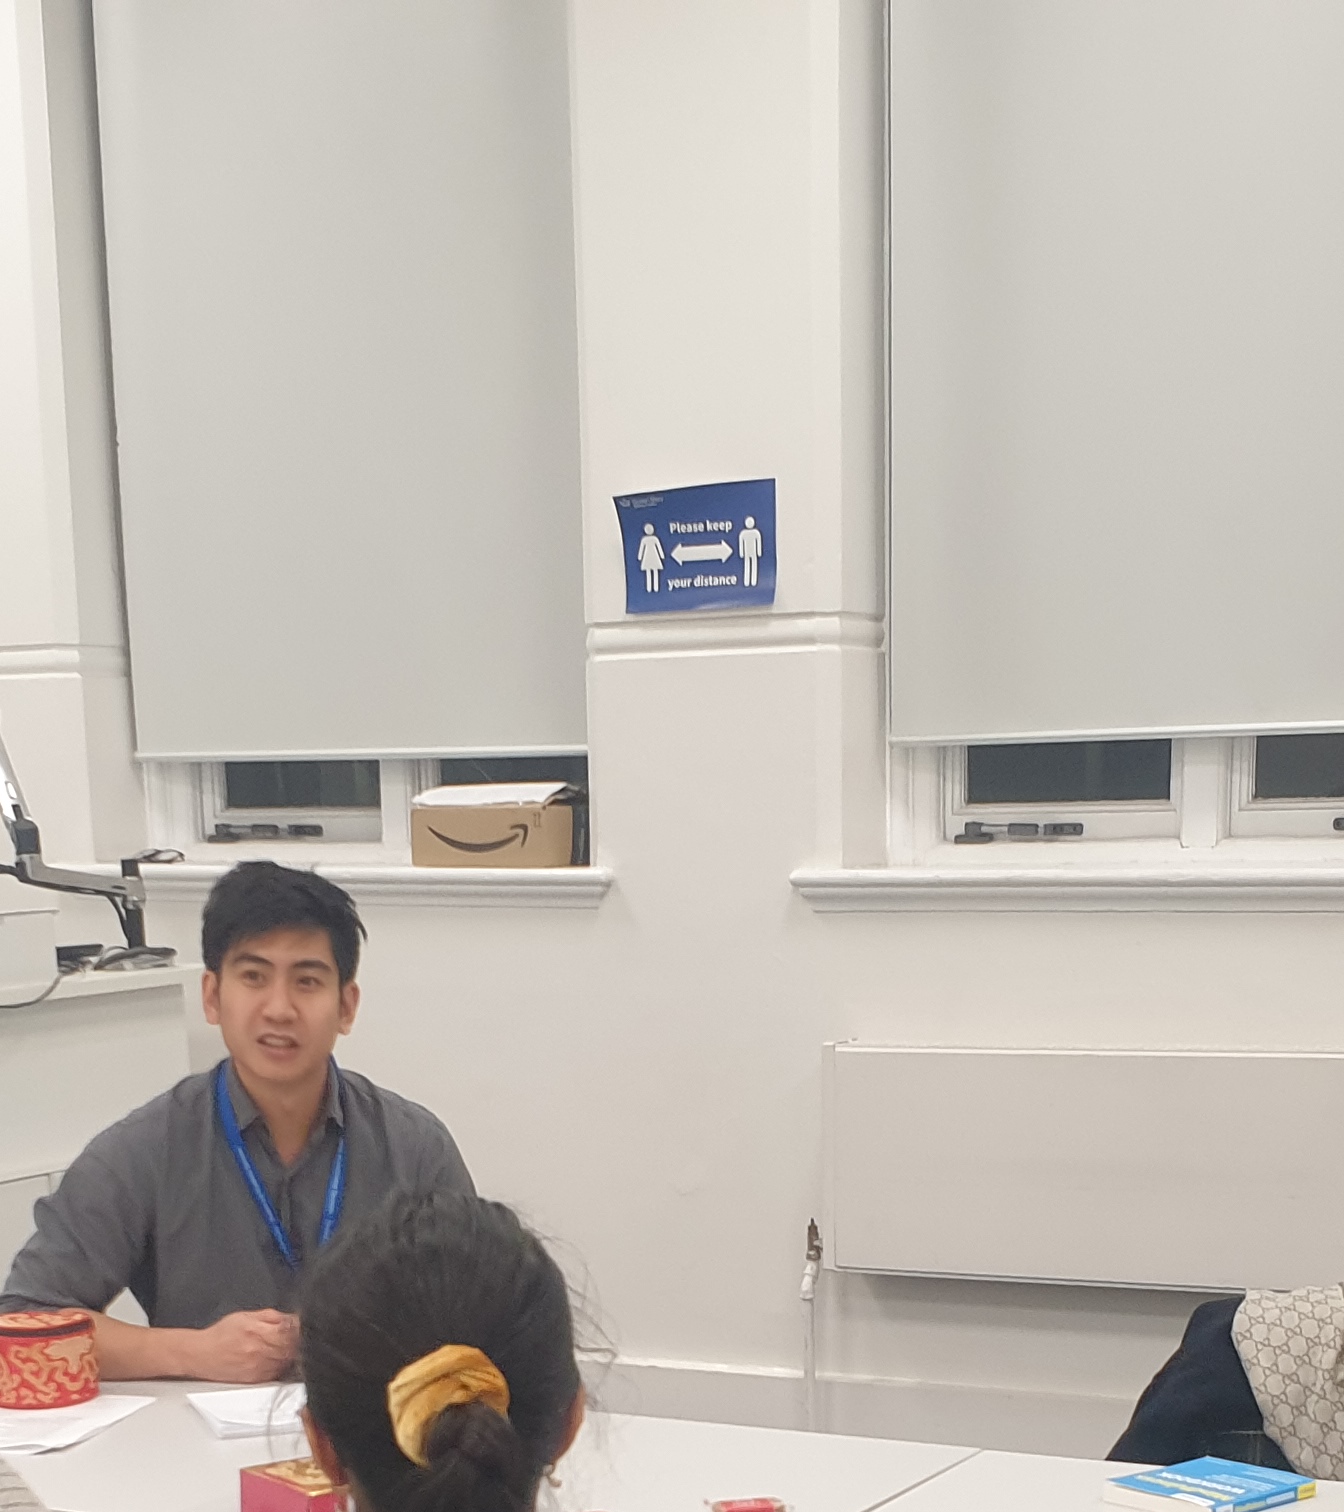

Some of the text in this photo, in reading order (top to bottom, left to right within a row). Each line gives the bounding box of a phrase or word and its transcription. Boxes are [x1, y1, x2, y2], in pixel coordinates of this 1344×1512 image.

[669, 520, 732, 534] Please keep
[667, 574, 737, 591] your distance
